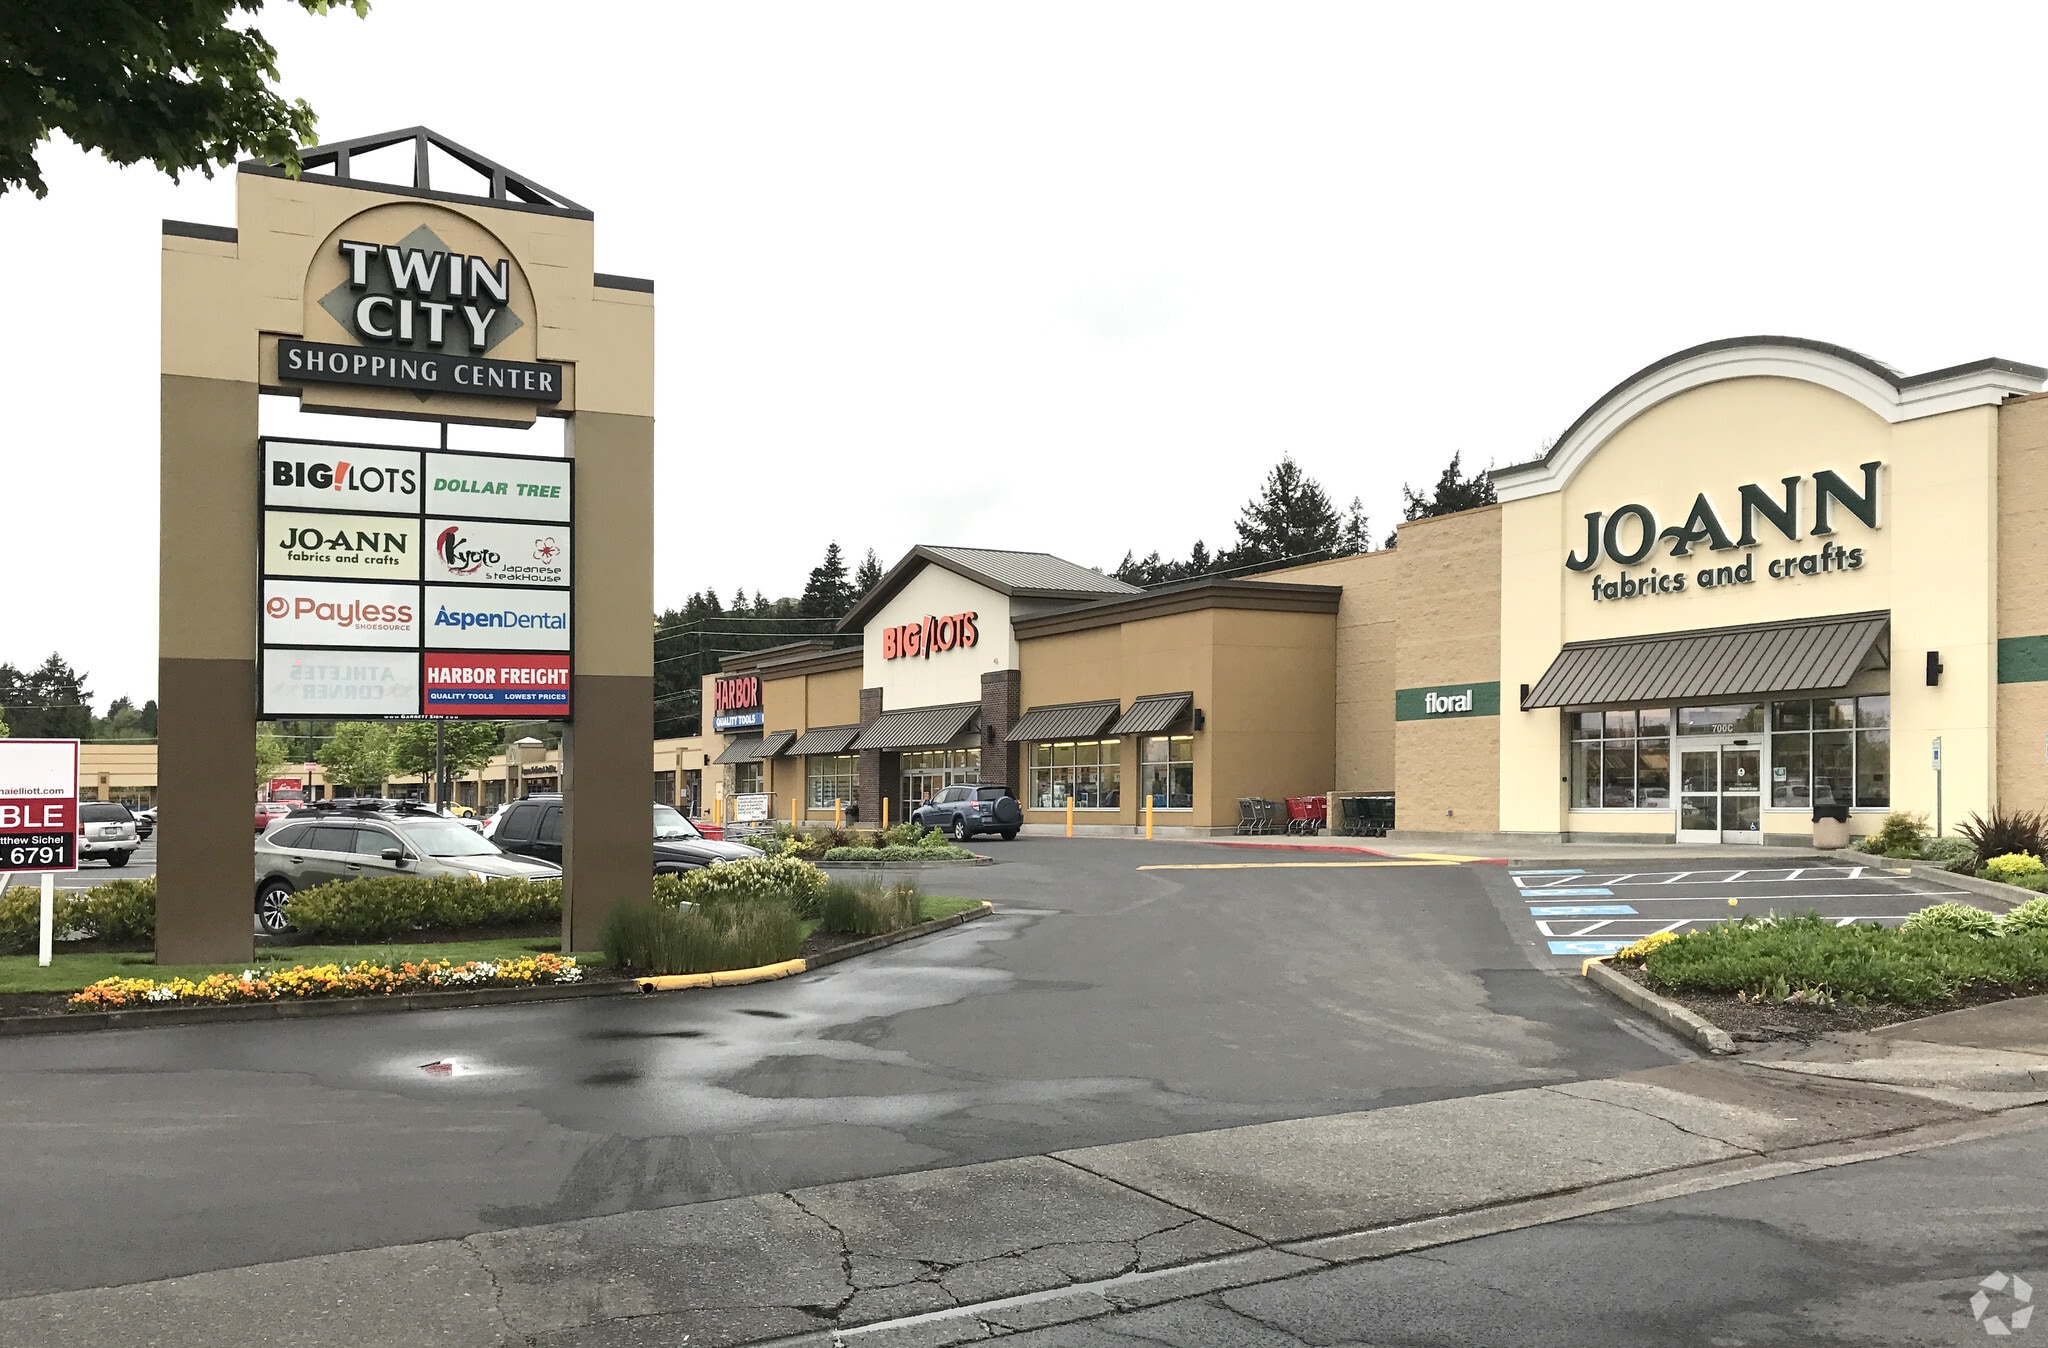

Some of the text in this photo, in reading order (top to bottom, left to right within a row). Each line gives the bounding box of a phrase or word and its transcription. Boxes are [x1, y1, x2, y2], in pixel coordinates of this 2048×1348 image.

[340, 240, 509, 304] TWIN
[354, 294, 498, 350] CITY
[288, 348, 553, 392] SHOPPING CENTER
[434, 478, 561, 498] DOLLAR TREE
[288, 551, 400, 565] fabrics and crafts
[445, 532, 500, 570] Kyoto
[501, 564, 562, 575] Japanese
[1592, 541, 1865, 602] fabrics and crafts
[294, 597, 413, 627] Payless
[427, 667, 569, 685] HARBOR FREIGHT
[714, 676, 758, 711] HARBOR
[1425, 689, 1472, 714] floral
[716, 714, 756, 727] QUALITY TOOLS
[31, 835, 64, 844] Sichel
[10, 846, 64, 865] 6791
